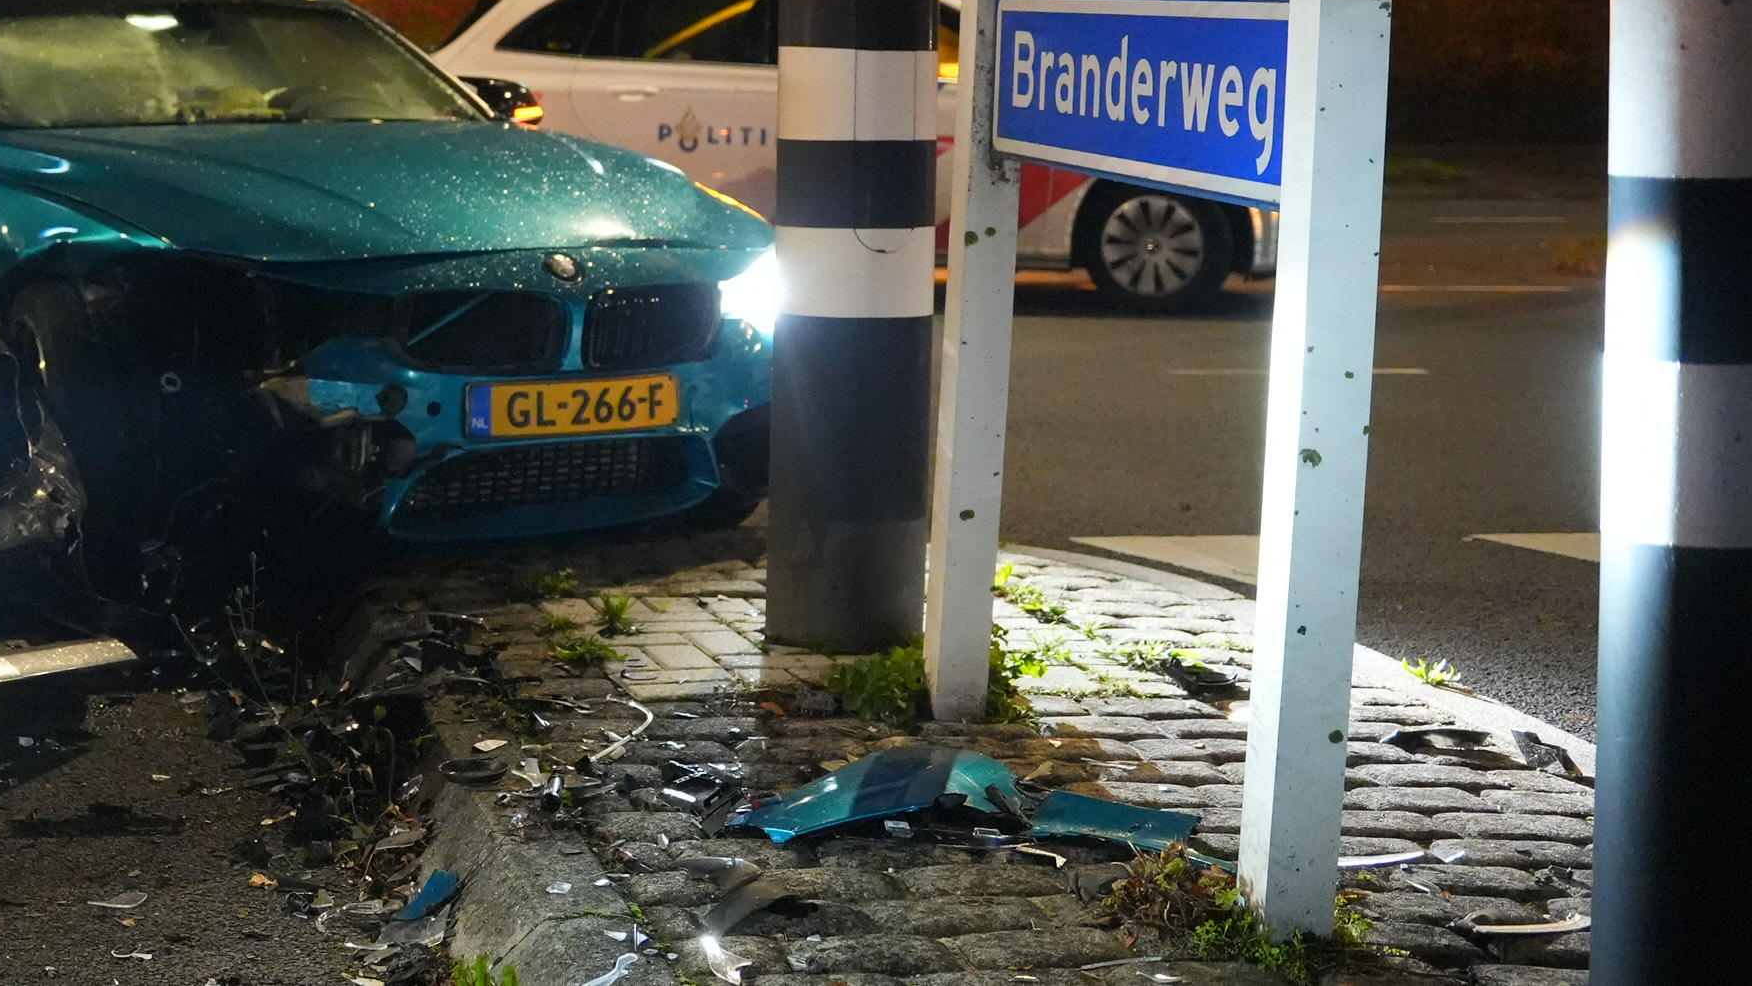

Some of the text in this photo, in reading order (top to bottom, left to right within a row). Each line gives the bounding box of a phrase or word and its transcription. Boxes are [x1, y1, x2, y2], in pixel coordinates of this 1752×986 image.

[1011, 30, 1277, 176] Branderweg
[657, 122, 768, 153] POLITI
[470, 417, 489, 430] NL
[506, 382, 664, 429] GL-266-F
